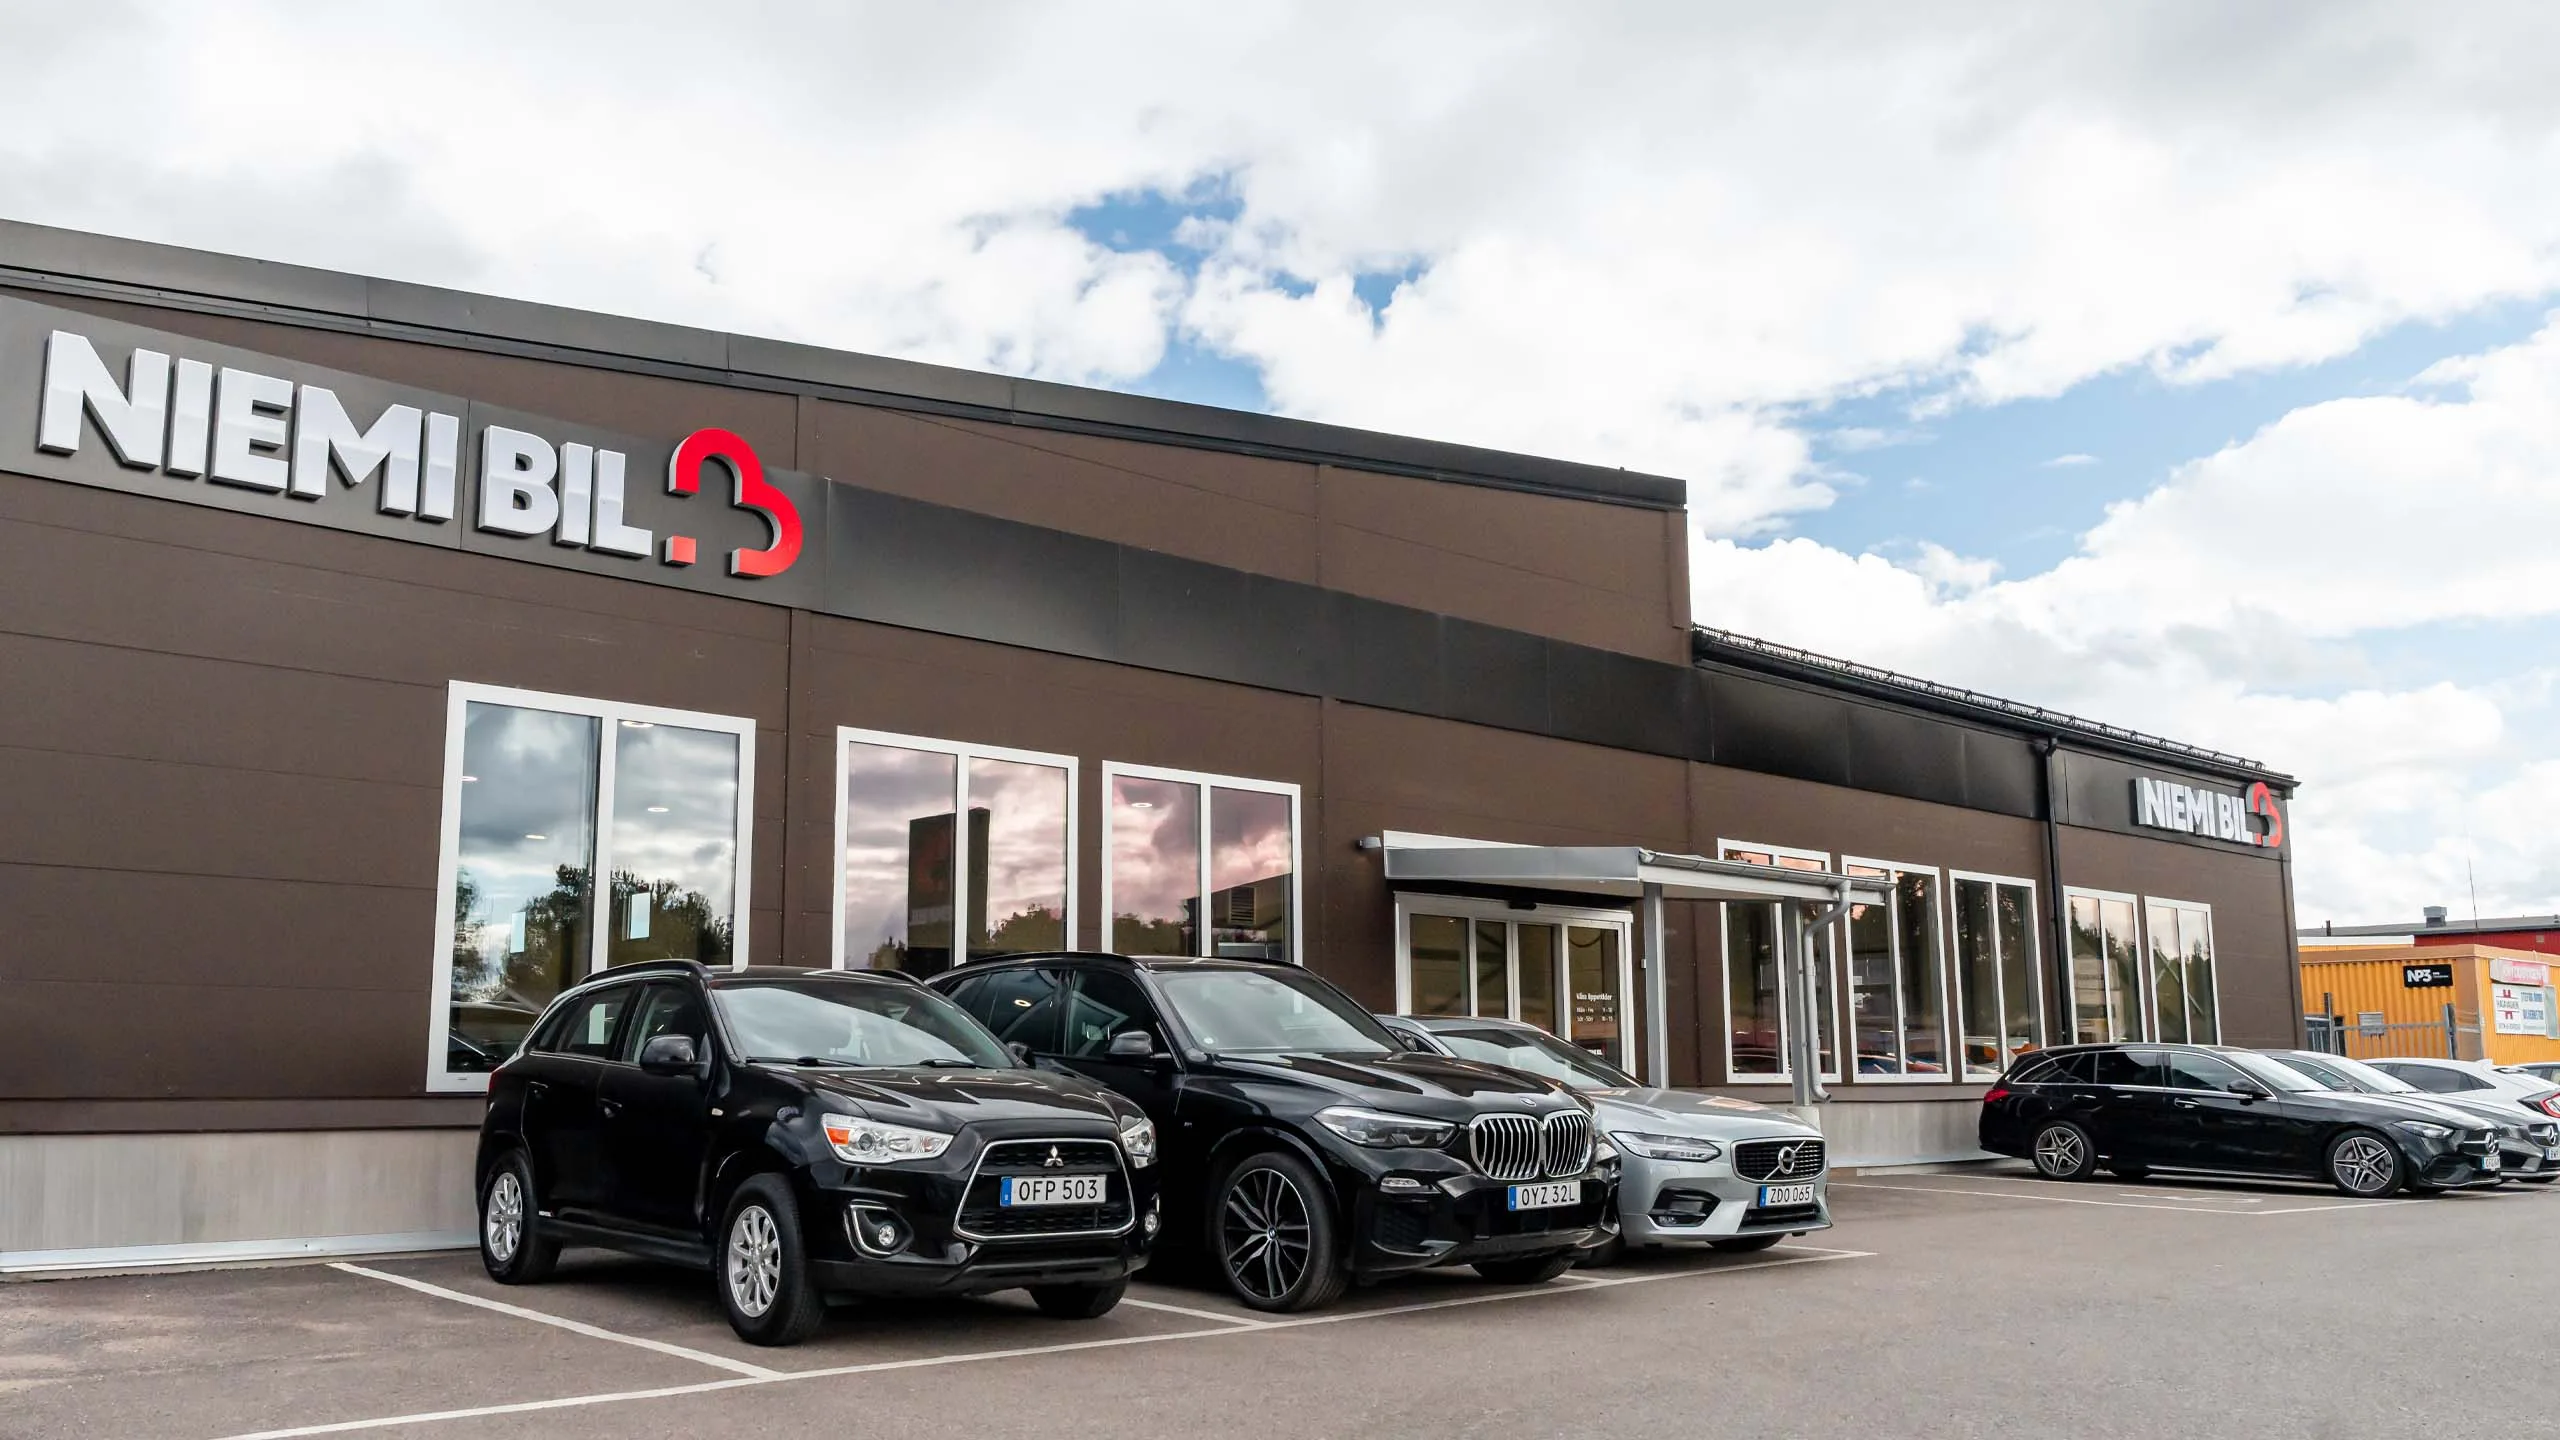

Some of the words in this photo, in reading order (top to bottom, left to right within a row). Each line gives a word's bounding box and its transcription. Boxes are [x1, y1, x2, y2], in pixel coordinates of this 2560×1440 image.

[38, 329, 460, 522] NIEMI
[478, 424, 653, 558] BIL
[2136, 776, 2217, 837] NIEMI
[2218, 792, 2255, 845] BIL
[2406, 968, 2432, 983] NP3
[1019, 1180, 1056, 1201] OFP
[1062, 1179, 1098, 1200] 503
[1521, 1186, 1548, 1206] OYZ
[1552, 1183, 1576, 1203] 32L
[1770, 1187, 1790, 1203] ZDO
[1792, 1186, 1811, 1201] 065
